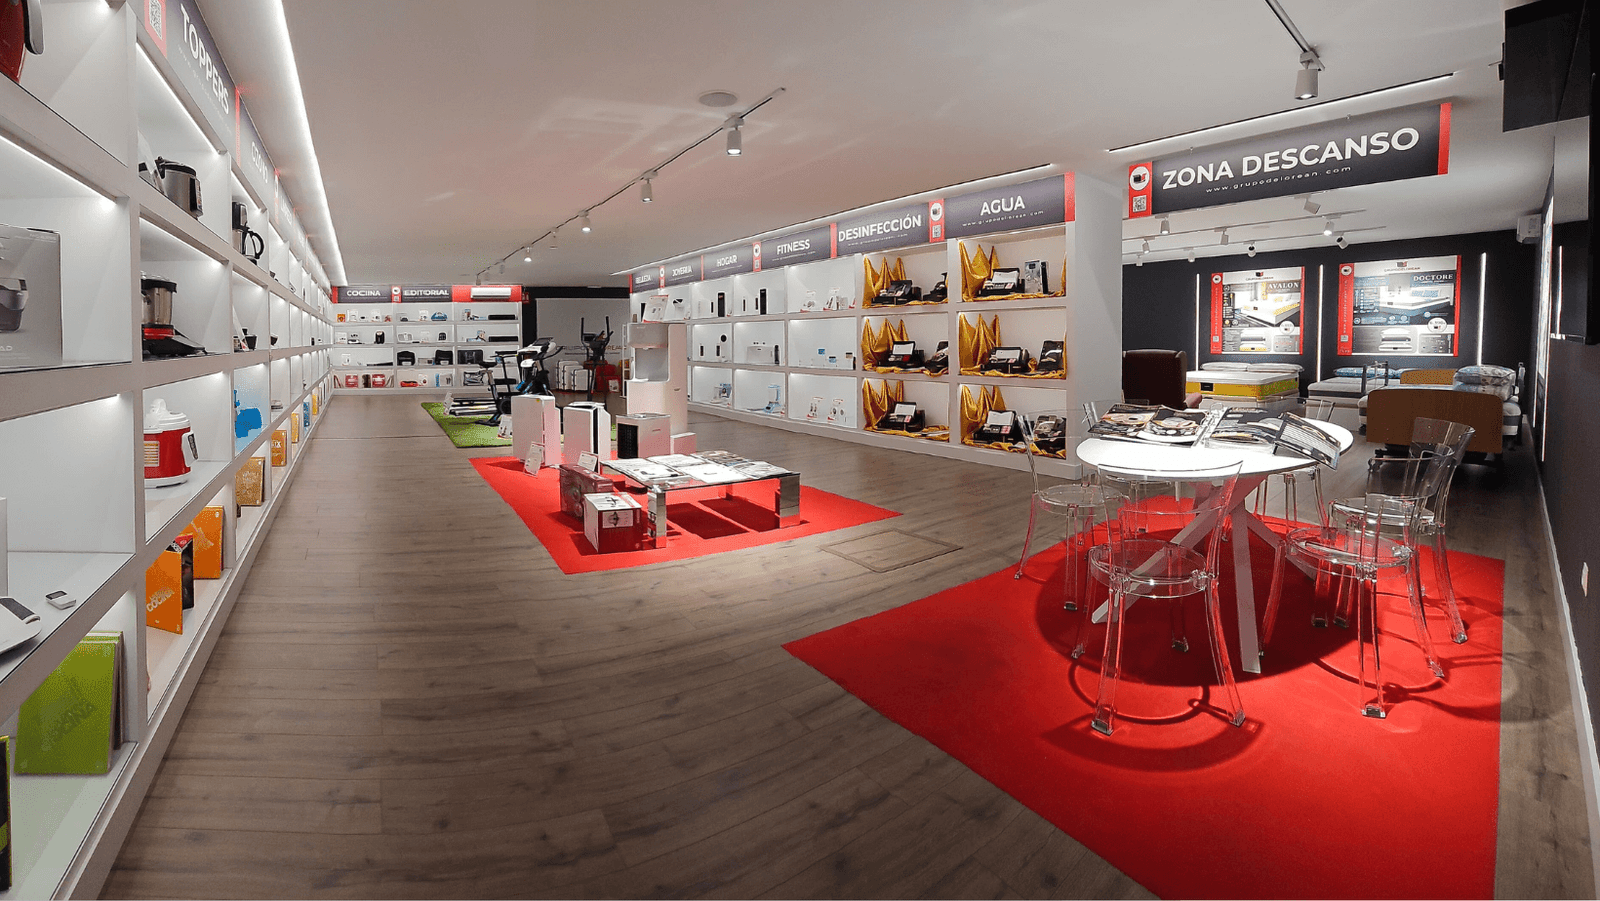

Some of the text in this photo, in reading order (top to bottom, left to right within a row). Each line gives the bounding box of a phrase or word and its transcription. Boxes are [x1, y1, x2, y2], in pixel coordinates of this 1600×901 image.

[180, 3, 229, 115] TOPPERS
[1162, 127, 1420, 190] ZONA DESCANSO
[980, 195, 1026, 216] AGUA
[838, 213, 922, 242] DESINFECCIÓN
[776, 238, 811, 256] FITNESS
[716, 254, 738, 267] HOGAR
[1268, 281, 1299, 289] AVALON
[1413, 273, 1453, 282] DOCTORE
